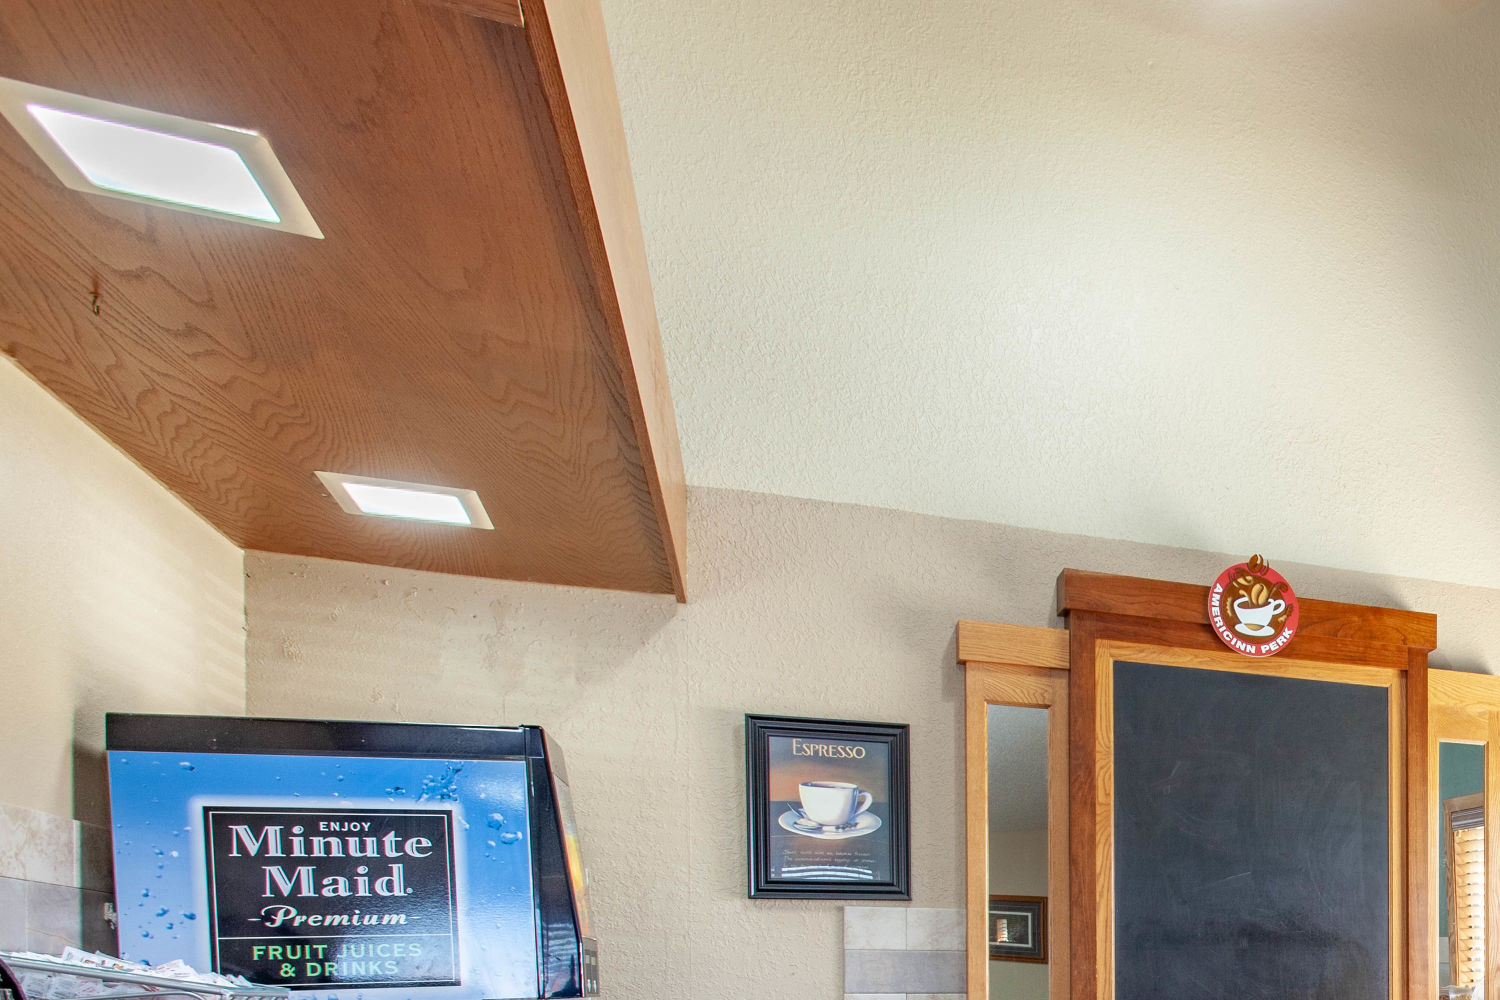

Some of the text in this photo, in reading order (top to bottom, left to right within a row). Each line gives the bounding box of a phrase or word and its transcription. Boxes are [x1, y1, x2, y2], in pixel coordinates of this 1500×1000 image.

[1211, 583, 1293, 654] AMERICINN PERK
[319, 821, 371, 832] ENJOY
[228, 825, 433, 858] Minute
[261, 863, 409, 897] Maid
[261, 904, 408, 929] Premium
[252, 943, 423, 961] FRUIT JUICES
[280, 960, 399, 978] & DRINKS
